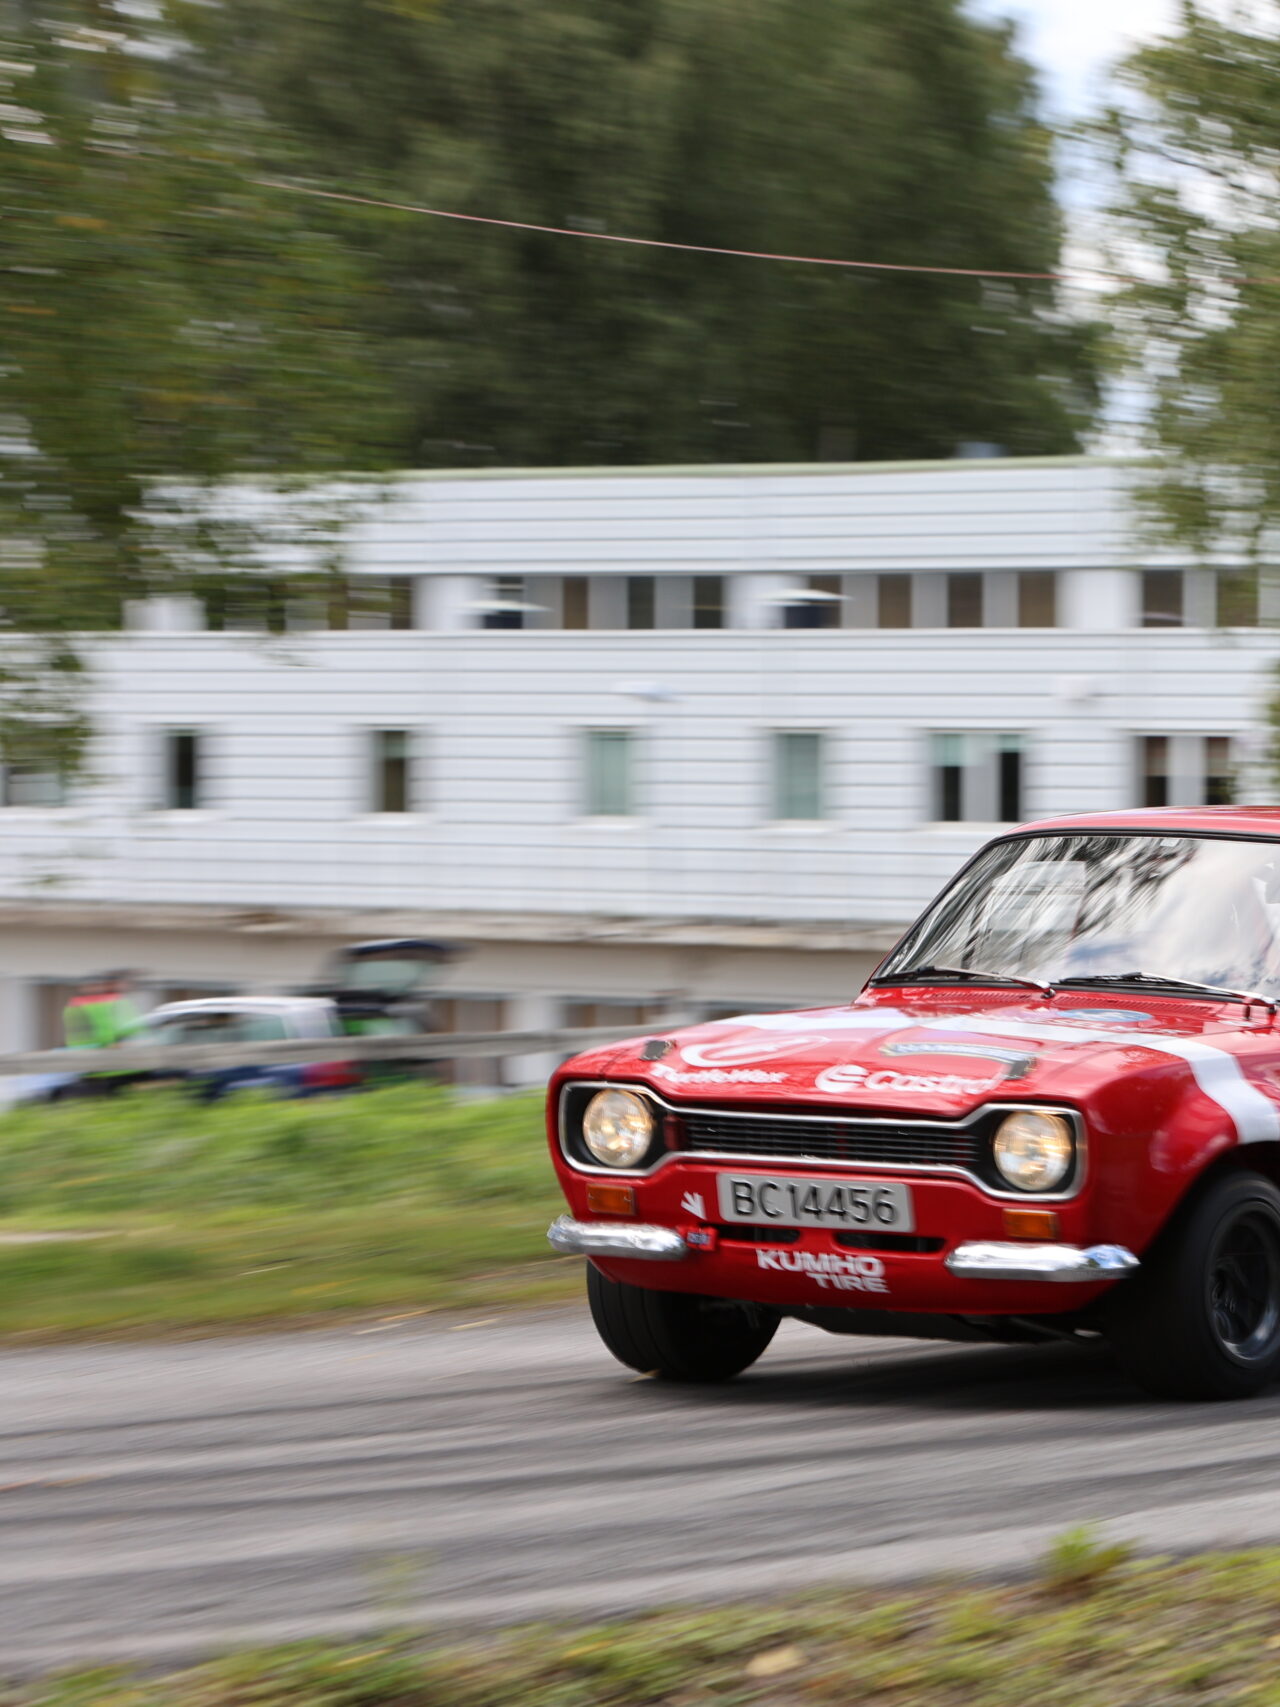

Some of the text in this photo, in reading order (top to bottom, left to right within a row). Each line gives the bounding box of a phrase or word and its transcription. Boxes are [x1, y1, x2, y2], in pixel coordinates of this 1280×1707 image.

[732, 1180, 896, 1225] BC14456
[756, 1249, 884, 1277] KUMHO
[806, 1272, 891, 1293] TIRE
